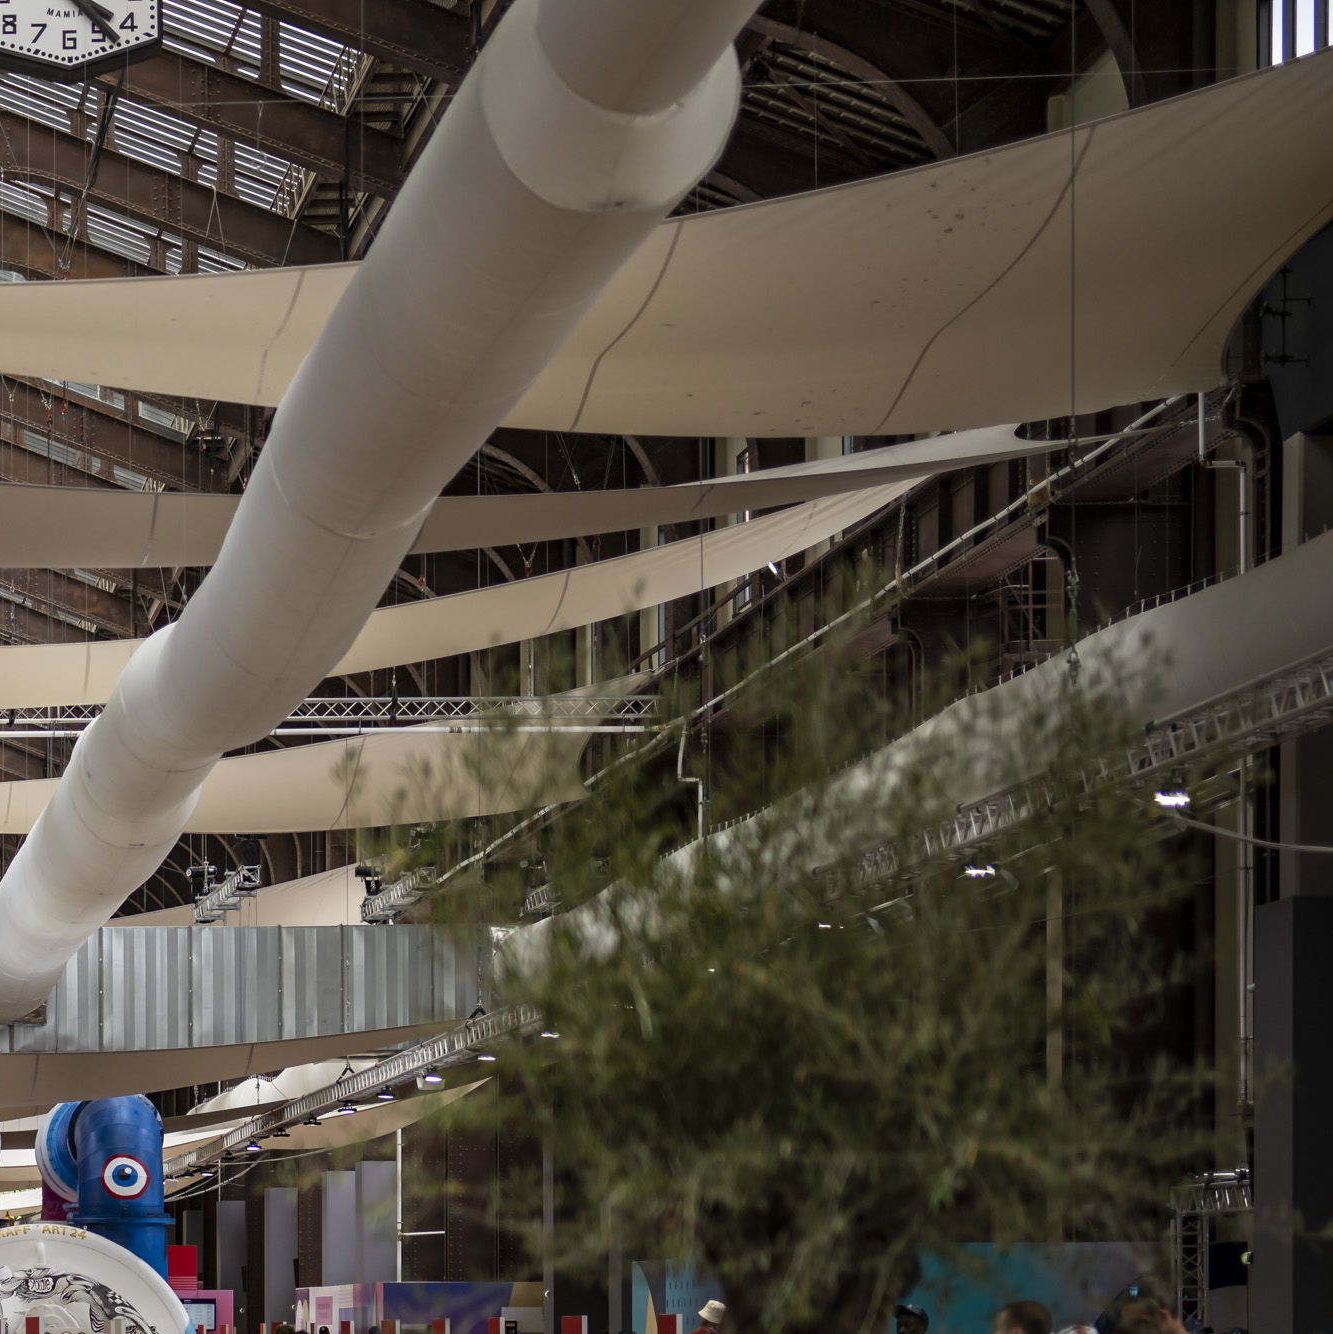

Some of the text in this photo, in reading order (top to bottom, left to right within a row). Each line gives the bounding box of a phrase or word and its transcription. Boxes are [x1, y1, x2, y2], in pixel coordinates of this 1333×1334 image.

[2, 14, 17, 35] 8
[119, 12, 138, 32] 4
[31, 23, 47, 44] 7
[62, 30, 77, 50] 6
